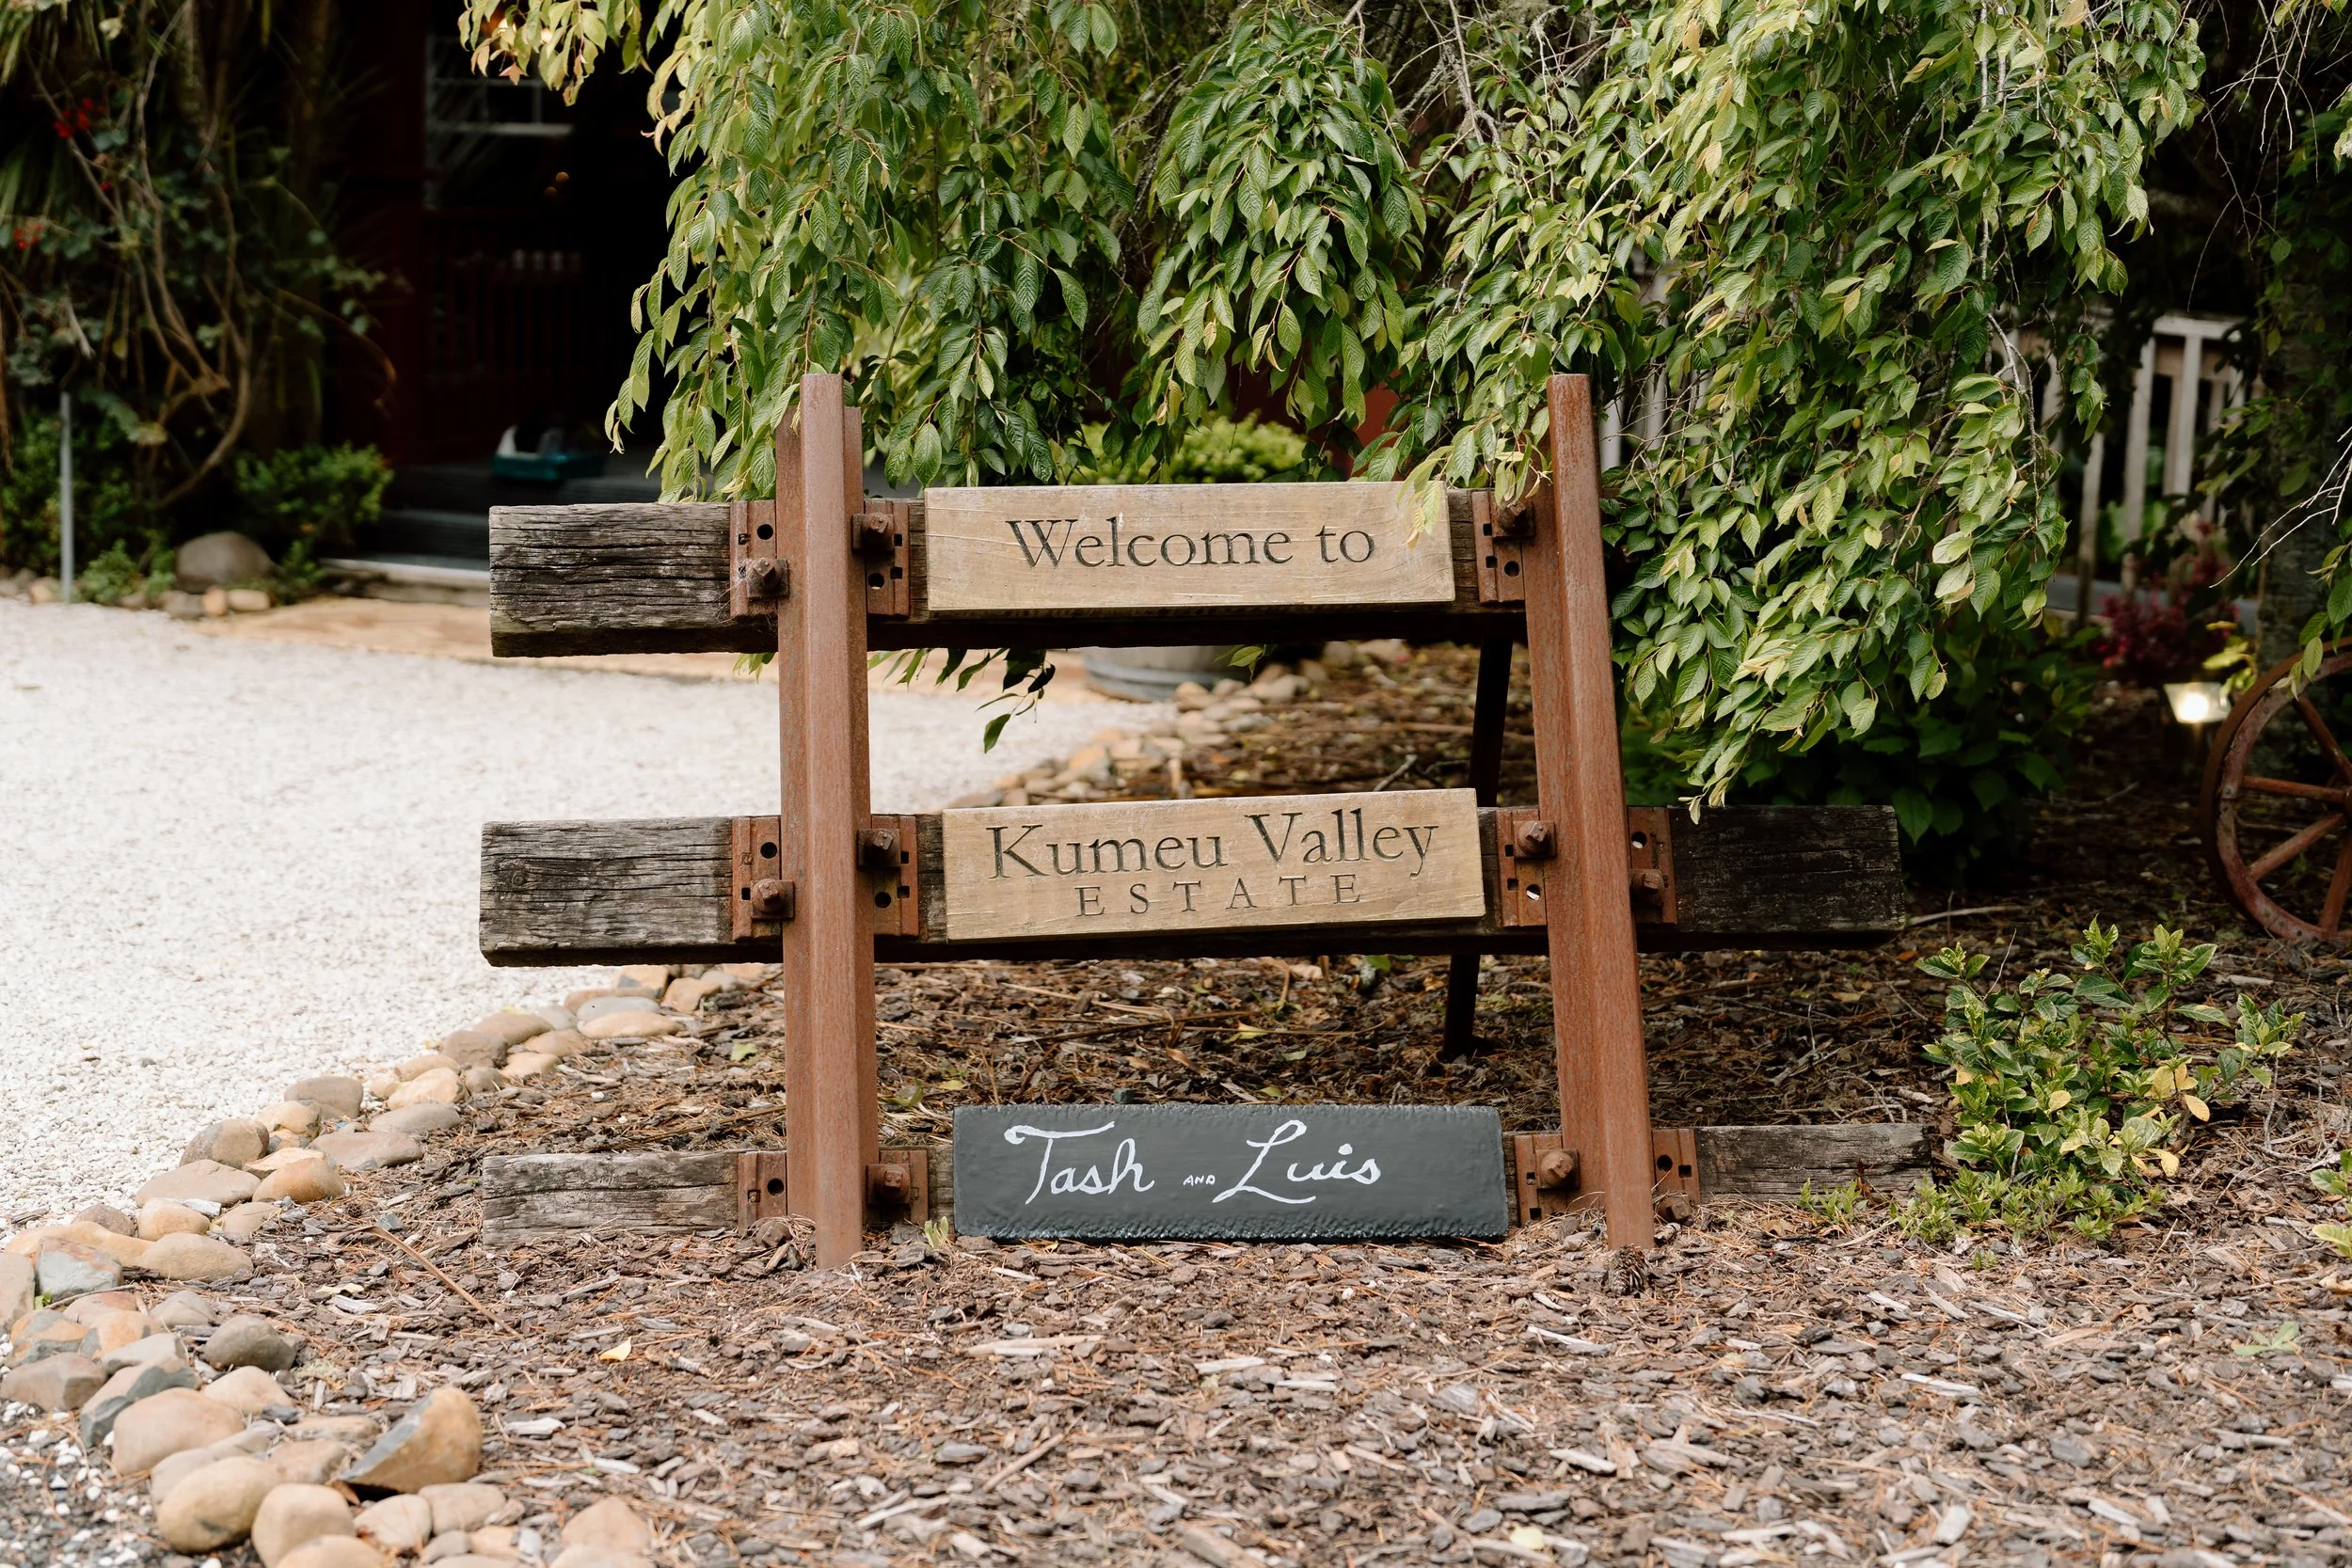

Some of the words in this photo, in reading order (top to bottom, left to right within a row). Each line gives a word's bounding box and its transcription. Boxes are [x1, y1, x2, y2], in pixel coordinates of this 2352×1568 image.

[1005, 516, 1294, 569] Welcome
[1315, 524, 1375, 563] to
[985, 823, 1229, 880] Kumeu
[1244, 808, 1439, 879] Valley
[1073, 874, 1362, 918] ESTATE
[1003, 1120, 1155, 1205] Tash
[1182, 1174, 1216, 1187] AND
[1212, 1119, 1382, 1204] Luis
